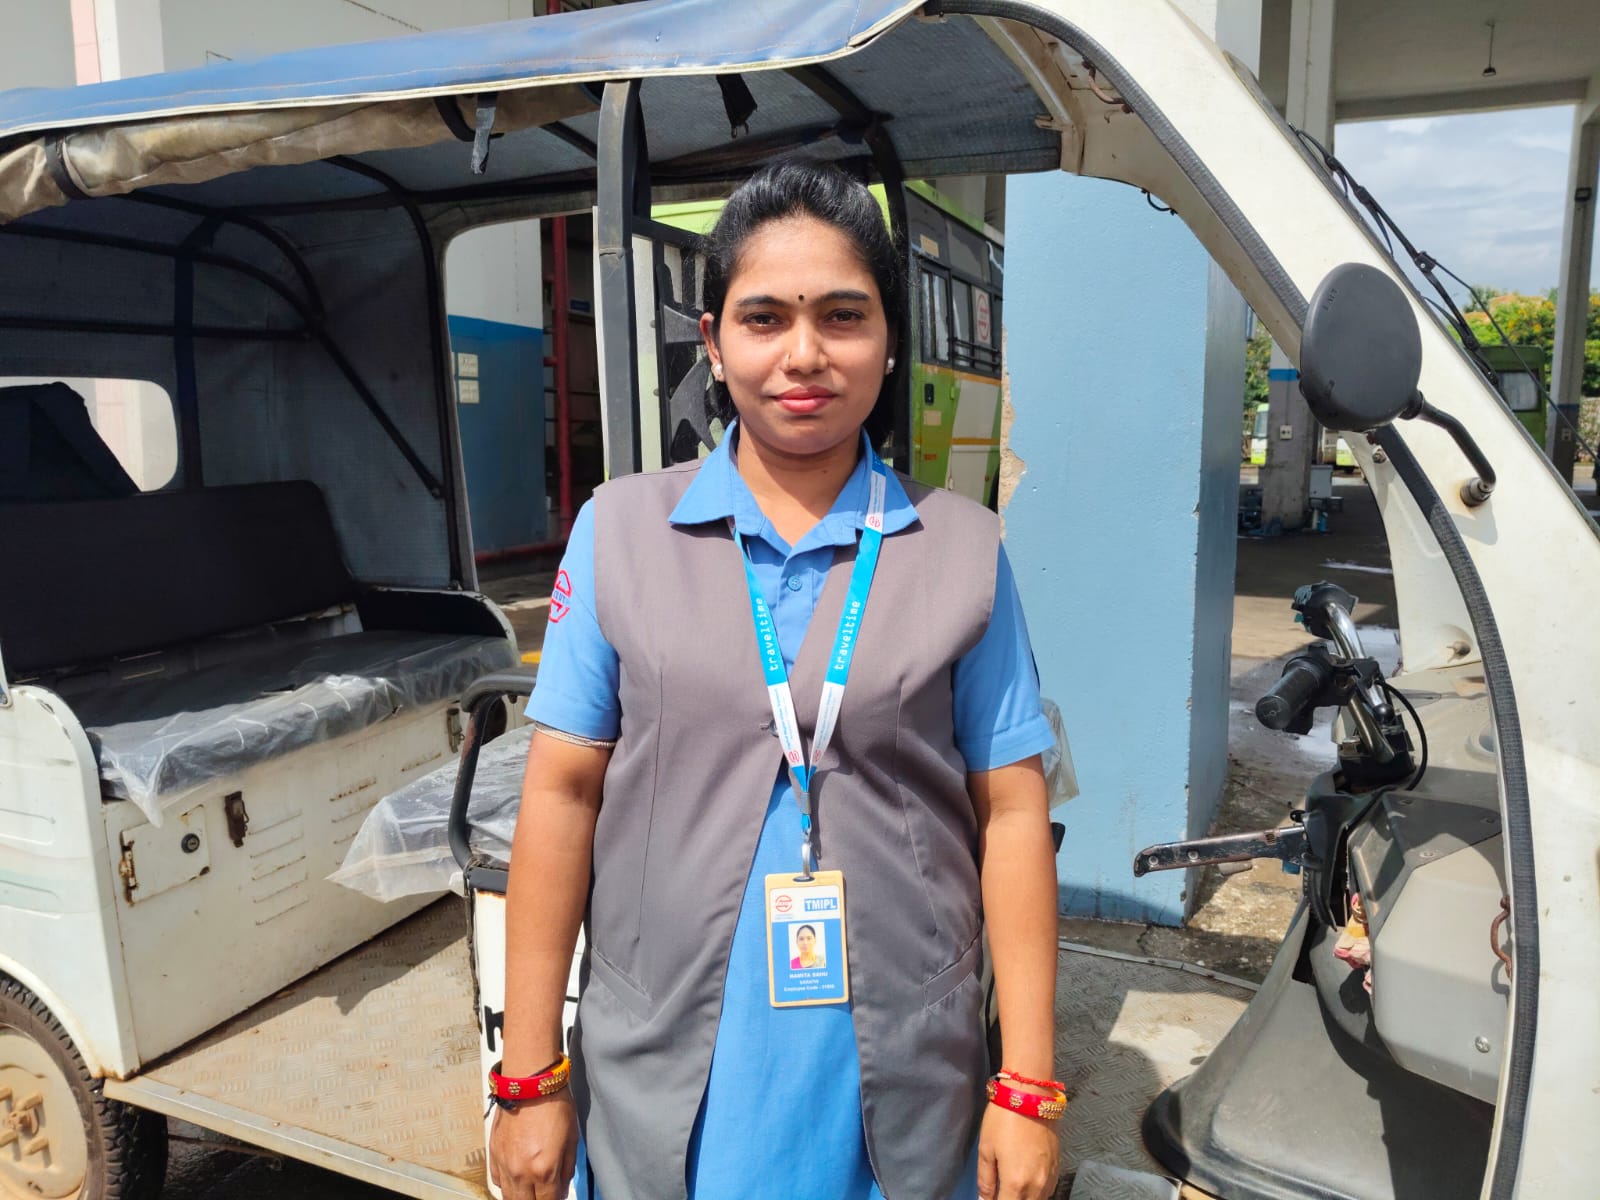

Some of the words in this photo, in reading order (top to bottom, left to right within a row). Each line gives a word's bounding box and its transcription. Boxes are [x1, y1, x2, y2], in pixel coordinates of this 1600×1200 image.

[755, 598, 779, 671] traveltime
[834, 600, 861, 671] traveltime
[806, 899, 836, 910] TMIPL
